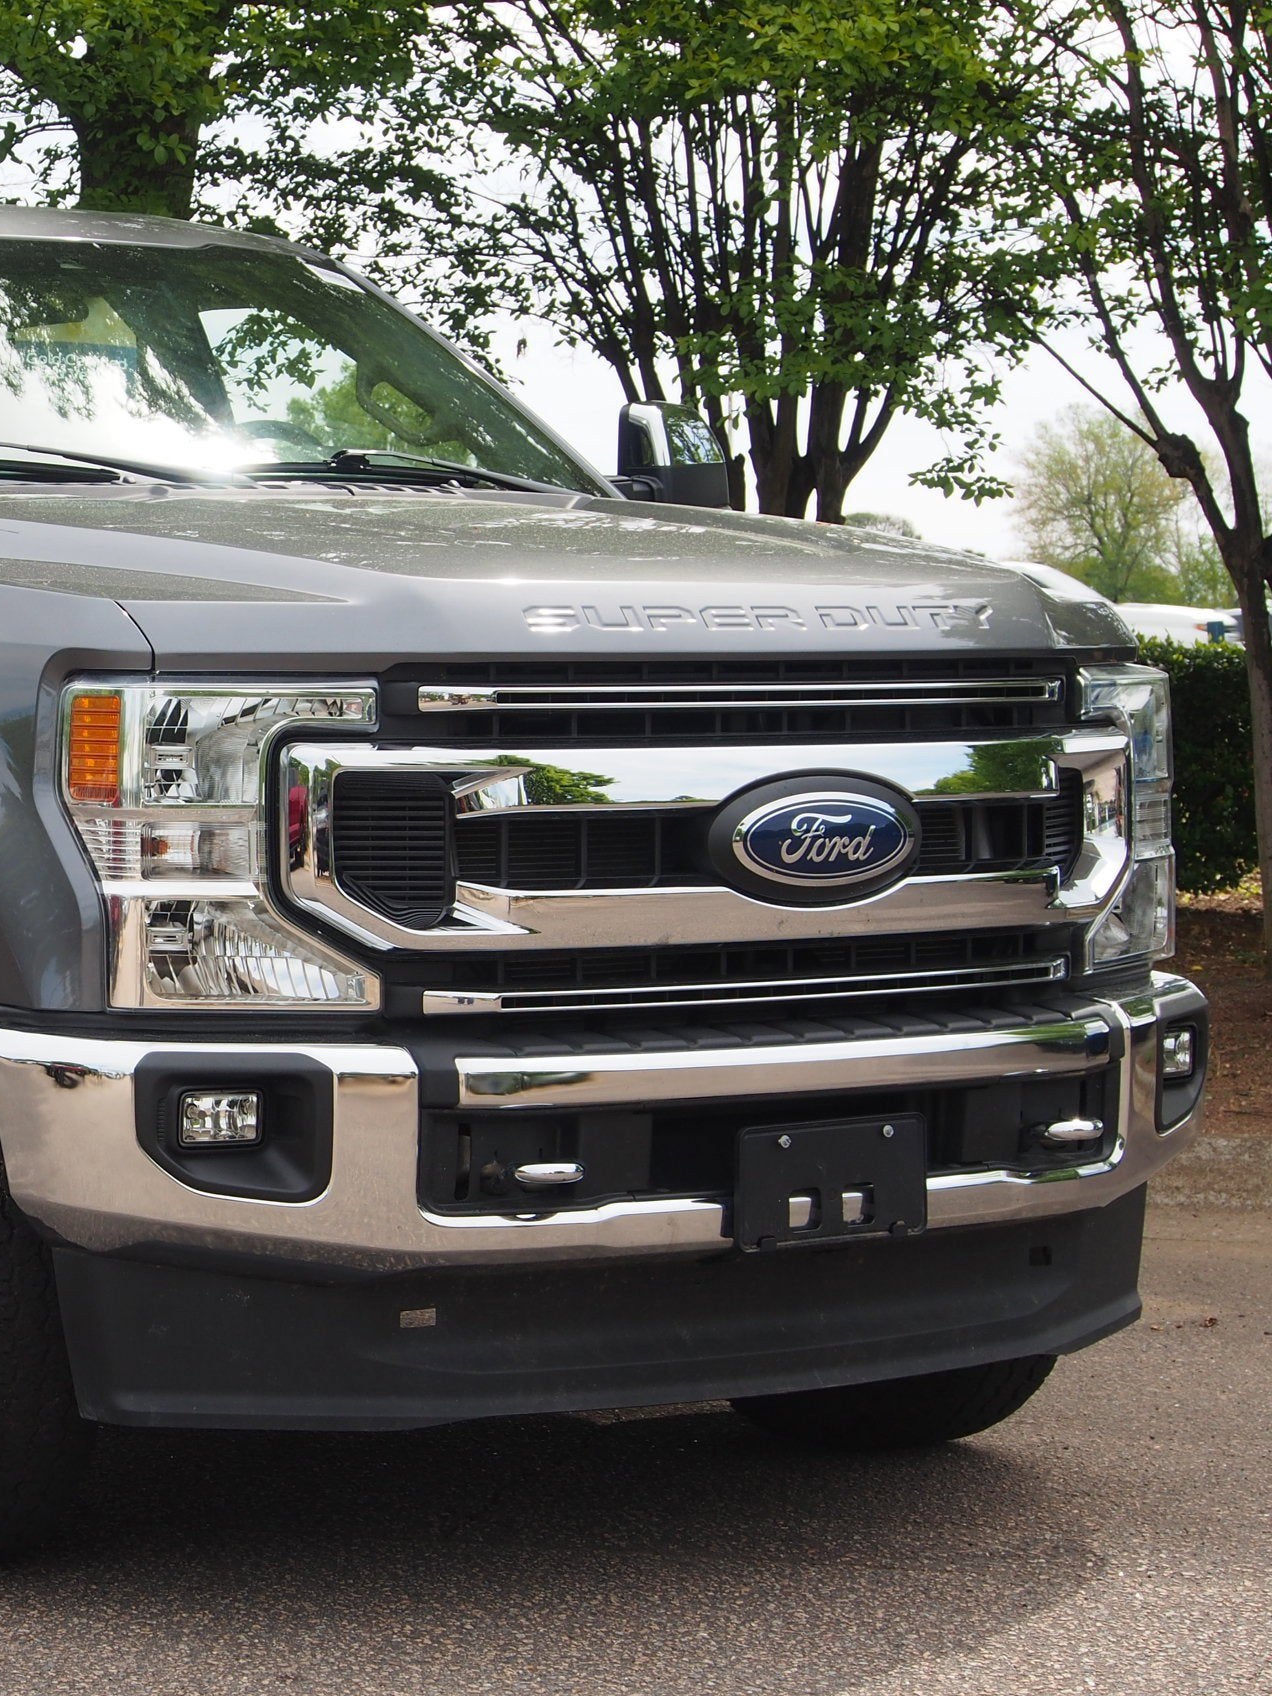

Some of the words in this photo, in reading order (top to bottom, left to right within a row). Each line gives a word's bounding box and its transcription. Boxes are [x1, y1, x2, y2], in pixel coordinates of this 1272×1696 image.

[522, 604, 807, 632] SUPER
[814, 604, 994, 631] DUTY
[780, 812, 876, 865] Ford
